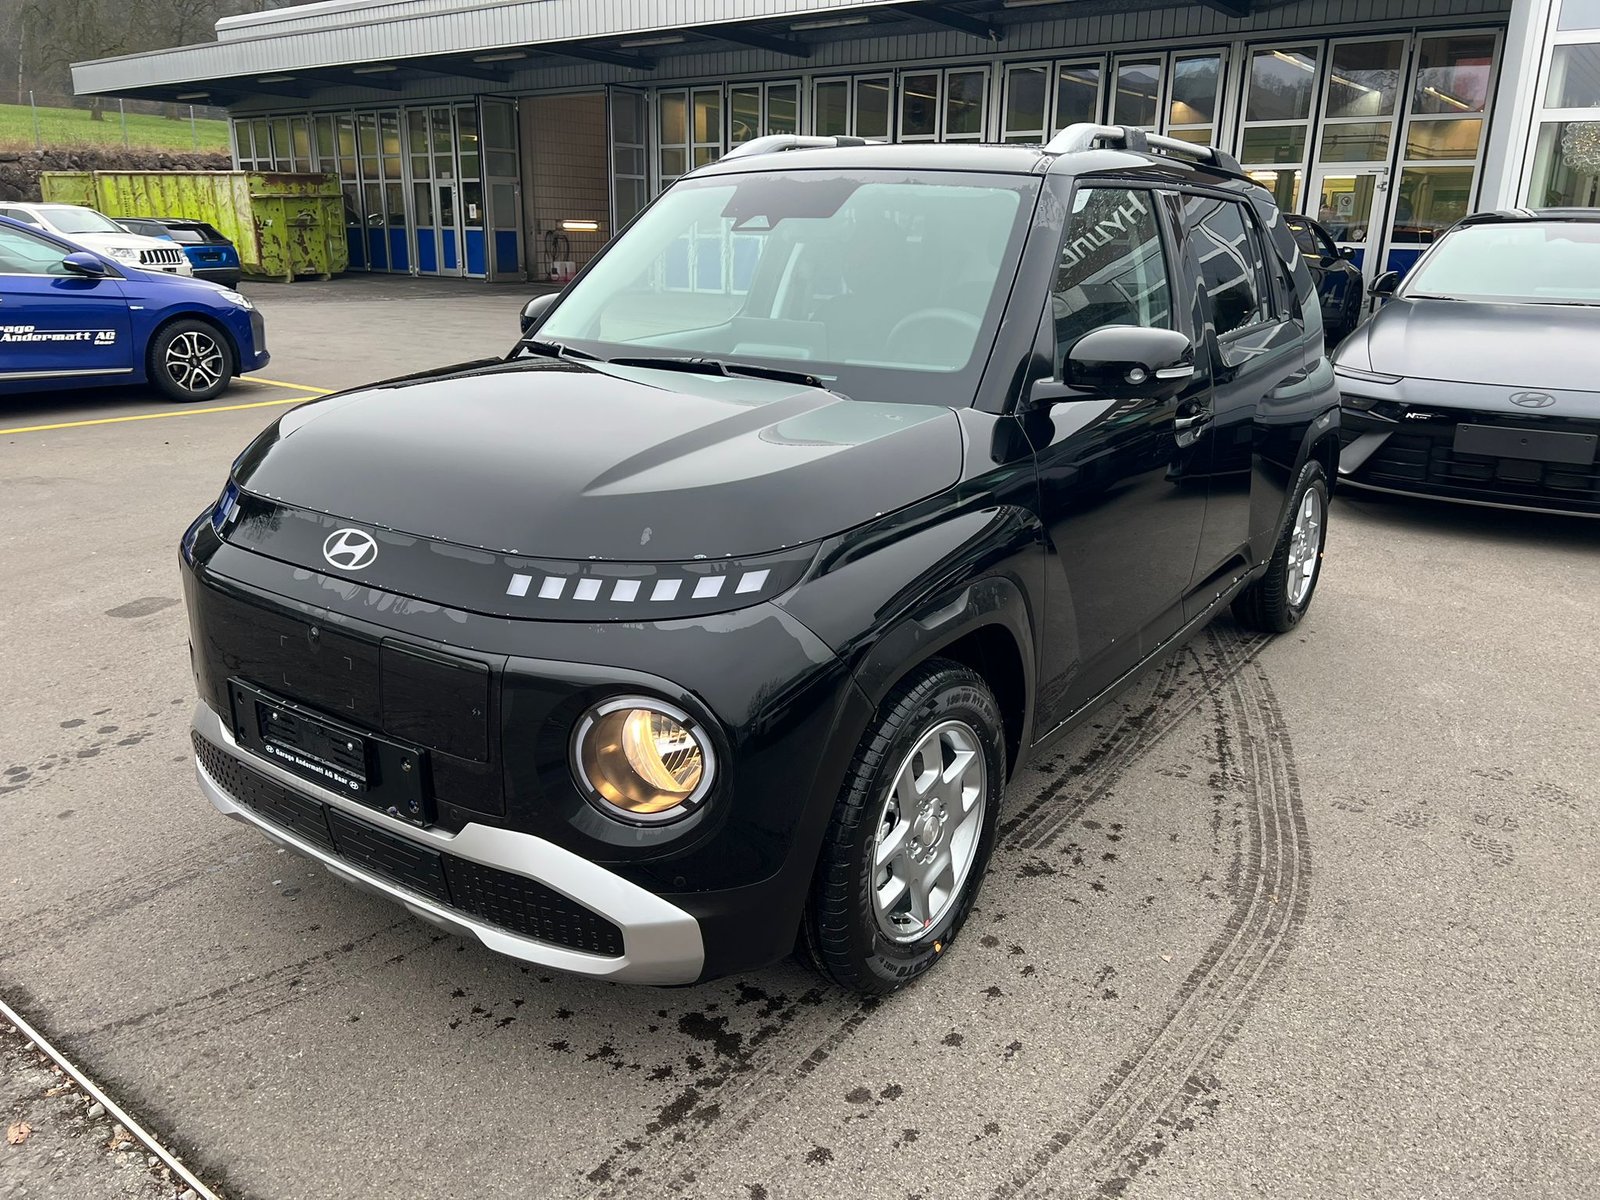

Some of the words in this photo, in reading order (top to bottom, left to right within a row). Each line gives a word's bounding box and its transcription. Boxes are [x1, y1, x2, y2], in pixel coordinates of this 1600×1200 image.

[0, 332, 91, 342] Andermatt
[95, 331, 116, 341] AG
[275, 748, 295, 762] Garage
[296, 756, 324, 775] Andermatt
[324, 769, 333, 779] AG
[334, 773, 348, 785] Baar
